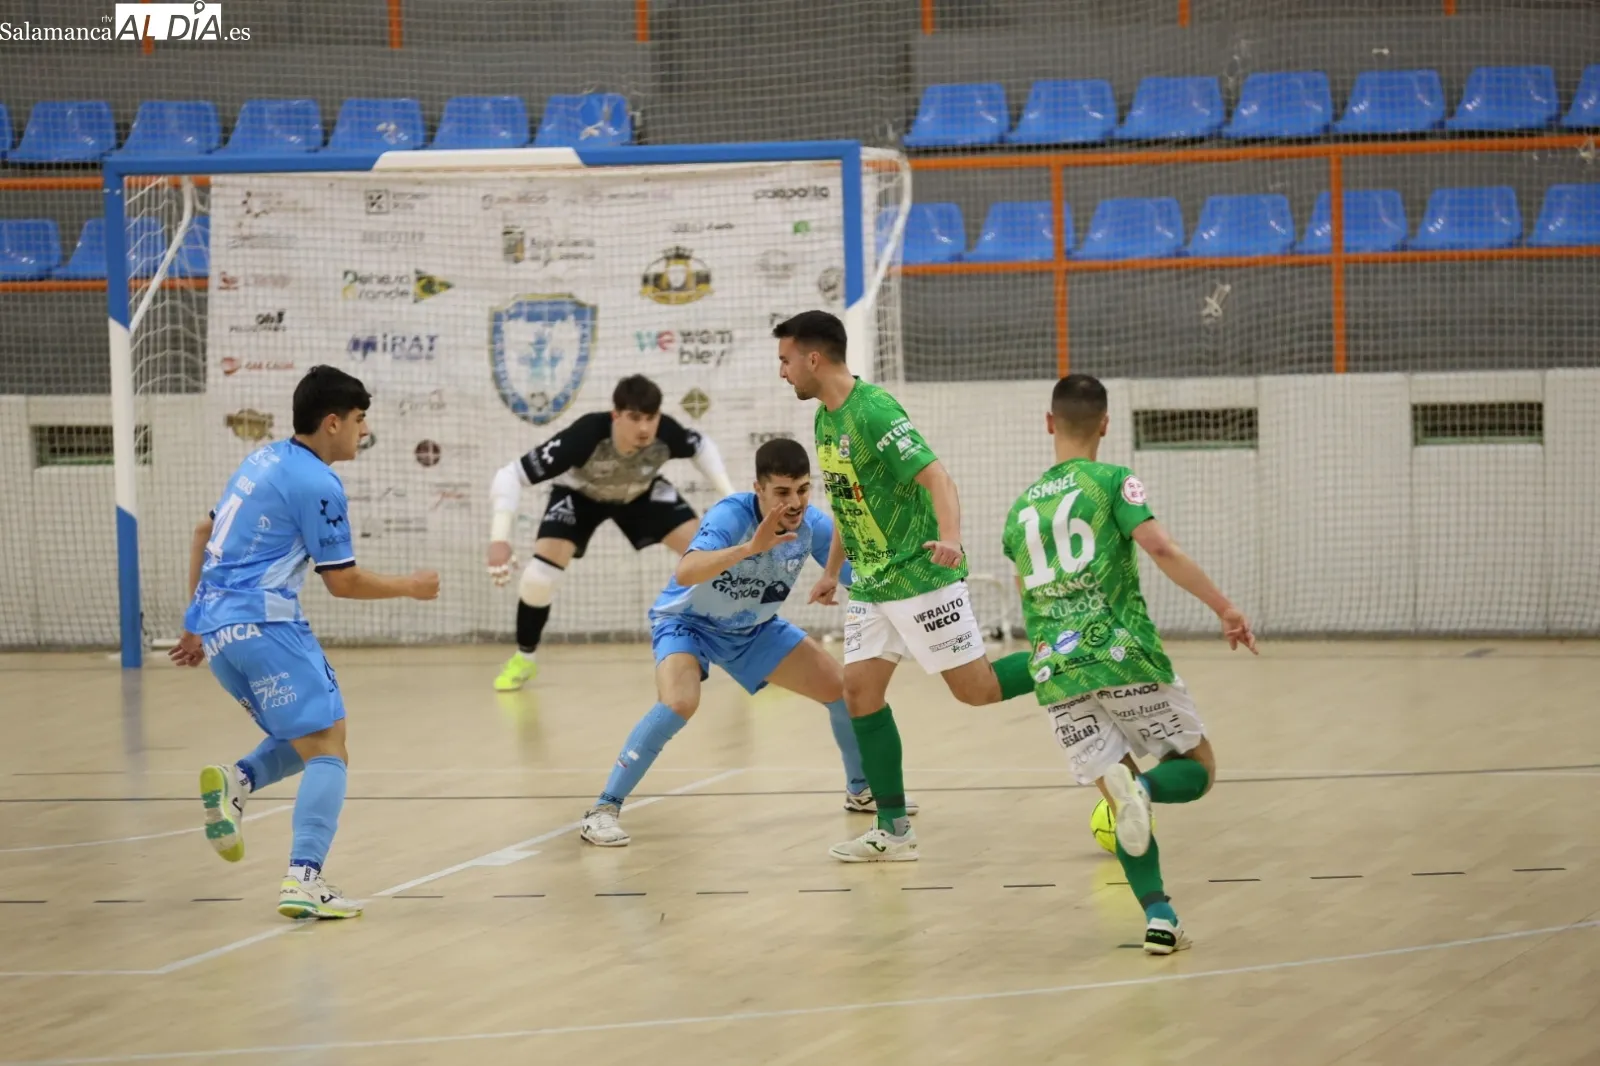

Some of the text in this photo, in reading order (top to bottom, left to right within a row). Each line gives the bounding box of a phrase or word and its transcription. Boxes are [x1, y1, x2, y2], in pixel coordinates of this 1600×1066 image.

[1027, 472, 1078, 502] ISMAEL
[1018, 488, 1096, 591] 16
[712, 579, 761, 600] Grande
[913, 597, 964, 624] VIFRAUTO
[923, 611, 961, 633] IVECO
[1137, 700, 1171, 716] Juan
